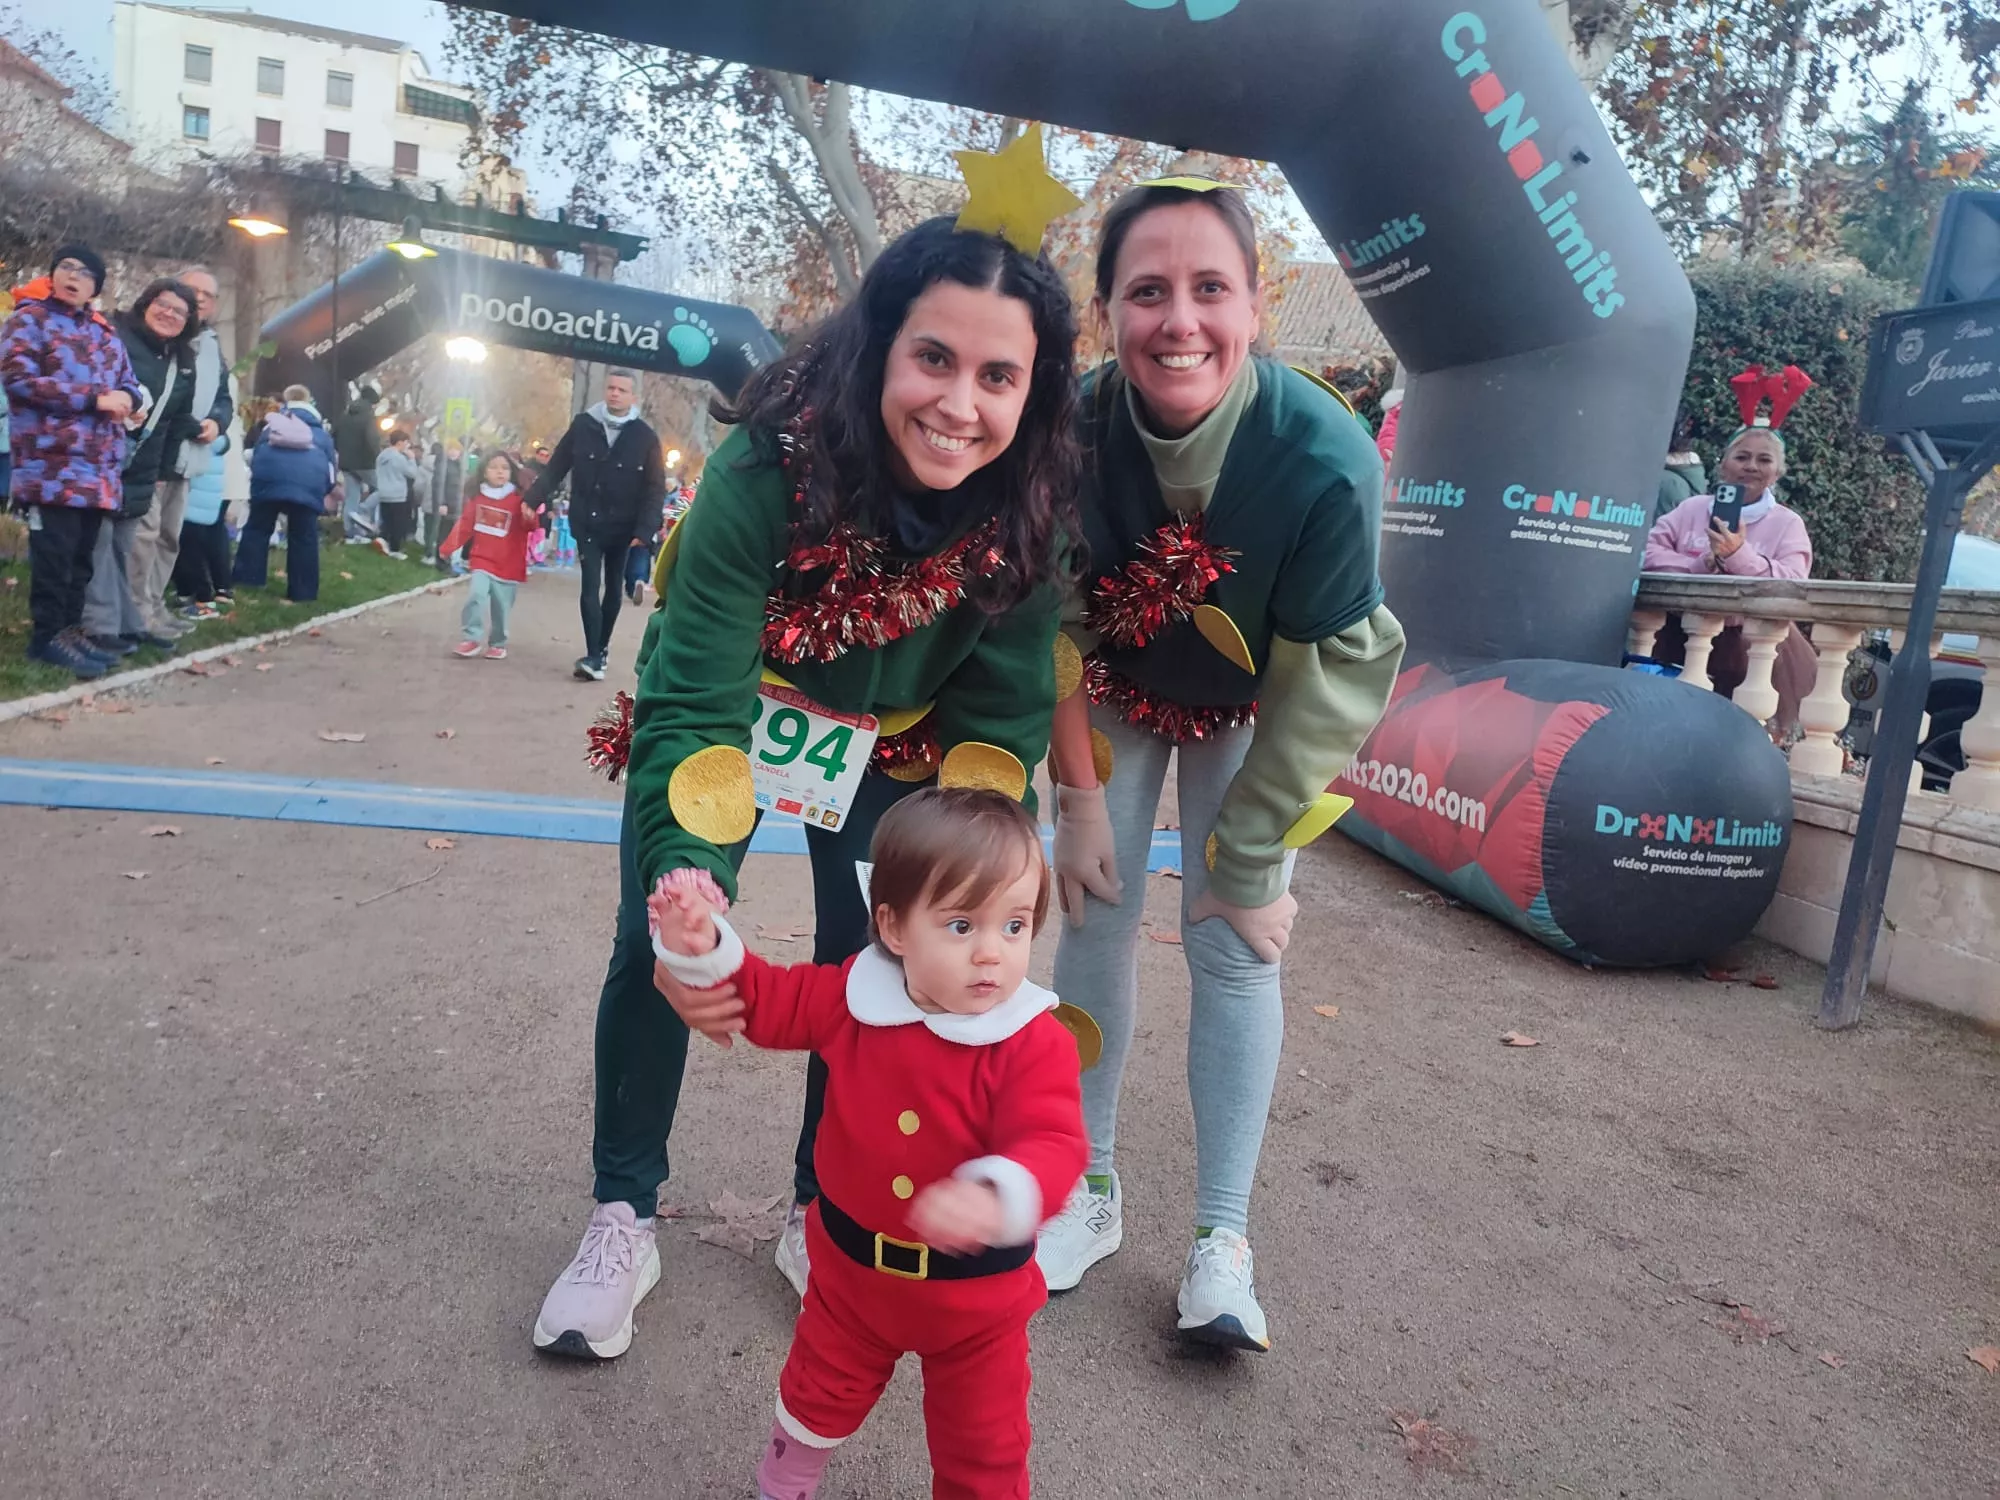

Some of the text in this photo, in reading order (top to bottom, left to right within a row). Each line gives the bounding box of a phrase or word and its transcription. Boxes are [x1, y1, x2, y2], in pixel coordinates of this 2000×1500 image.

[457, 292, 660, 351] podoactiva
[1906, 347, 1994, 397] Javier
[1518, 515, 1557, 530] Servicio
[1557, 521, 1571, 532] de
[1510, 530, 1548, 542] gestión
[1549, 533, 1562, 544] de
[752, 697, 855, 783] 94
[753, 762, 790, 779] CANDELA
[1642, 844, 1688, 861] Servicio
[1690, 849, 1705, 862] de
[1744, 855, 1753, 867] y
[1613, 856, 1765, 880] vídeo promocional deportivo
